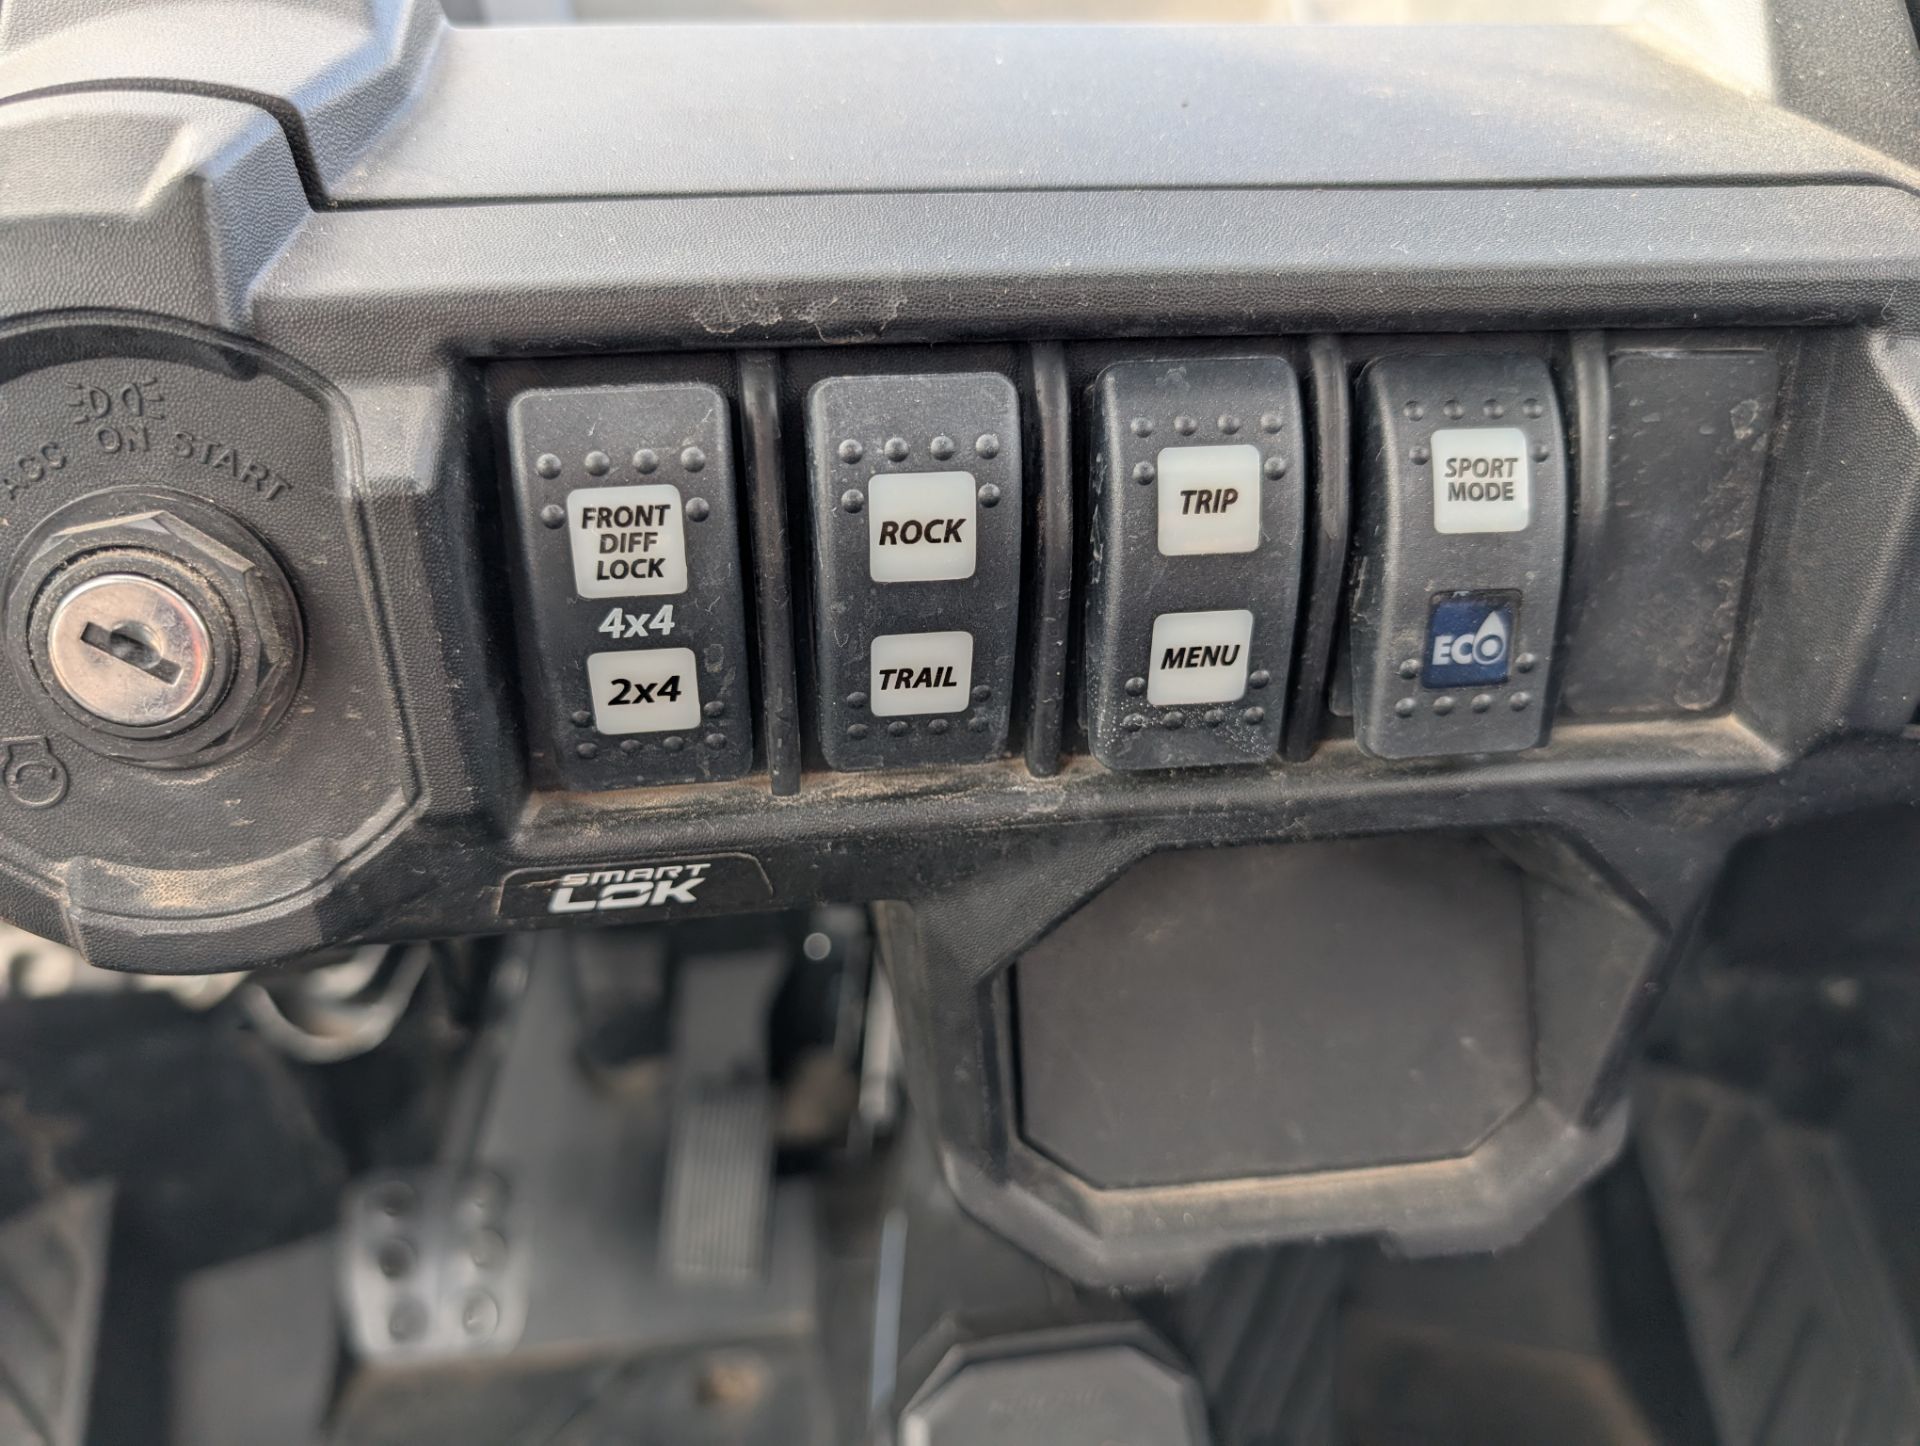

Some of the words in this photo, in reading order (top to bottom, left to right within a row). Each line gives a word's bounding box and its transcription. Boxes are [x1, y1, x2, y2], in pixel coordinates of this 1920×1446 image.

[94, 425, 150, 453] ON
[173, 430, 293, 500] START
[1444, 457, 1518, 479] SPORT
[1180, 488, 1239, 515] TRIP
[1447, 482, 1515, 502] MODE
[581, 504, 671, 530] FRONT
[599, 532, 659, 554] DIFF
[879, 518, 966, 546] ROCK
[596, 558, 666, 581] LOCK
[599, 604, 676, 639] 4x4
[1431, 611, 1507, 666] ECO
[1160, 644, 1240, 670] MENU
[607, 675, 682, 707] 2x4
[879, 666, 958, 691] TRAIL
[560, 862, 711, 886] SMART
[547, 877, 706, 914] LOK
